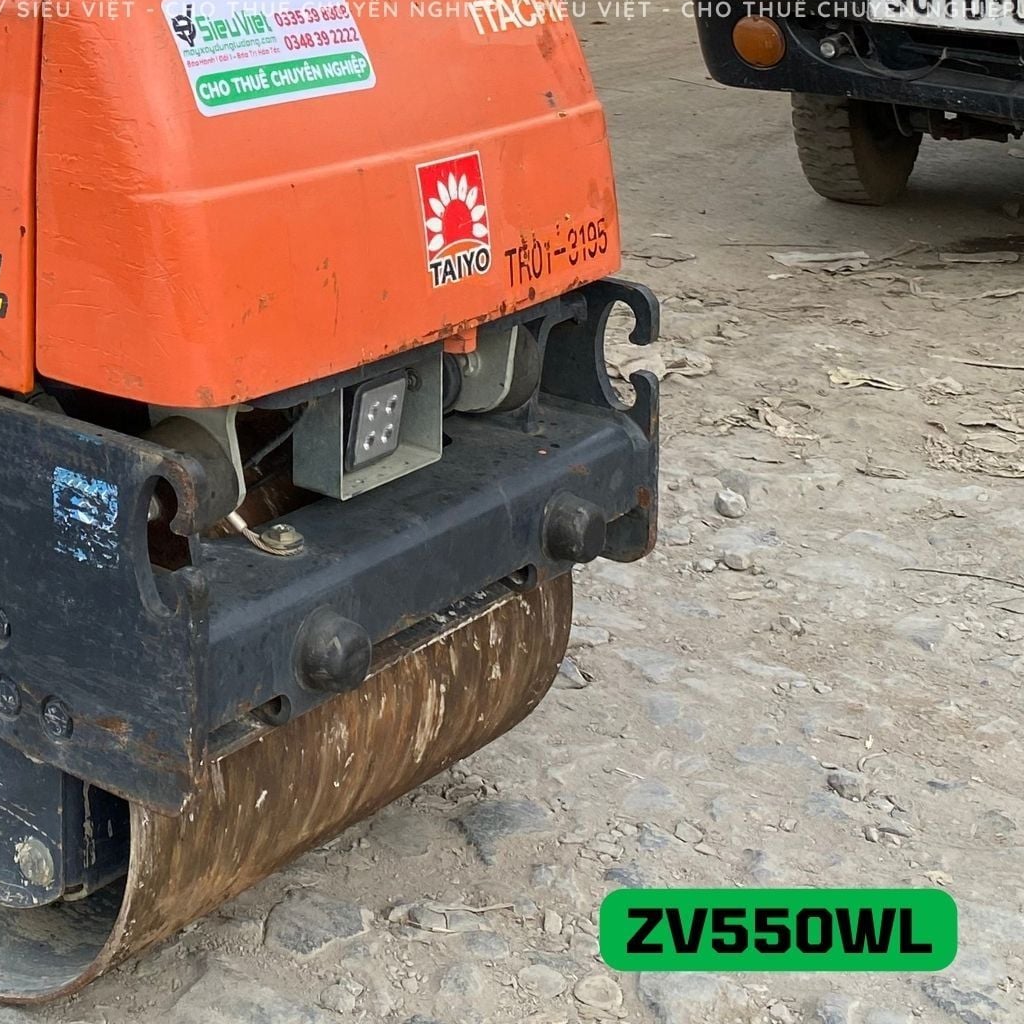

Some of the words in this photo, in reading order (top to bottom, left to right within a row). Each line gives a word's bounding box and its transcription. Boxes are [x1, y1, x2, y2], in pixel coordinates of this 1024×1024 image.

[195, 10, 273, 42] SieuViet
[274, 9, 305, 27] 0335
[284, 33, 315, 51] 0348
[315, 30, 330, 47] 39
[330, 27, 360, 44] 2222
[199, 80, 230, 100] CHO
[230, 68, 270, 95] THUÊ
[271, 62, 326, 88] CHUYÊN
[326, 55, 367, 79] NGHIỆP
[429, 245, 492, 288] TAIYO
